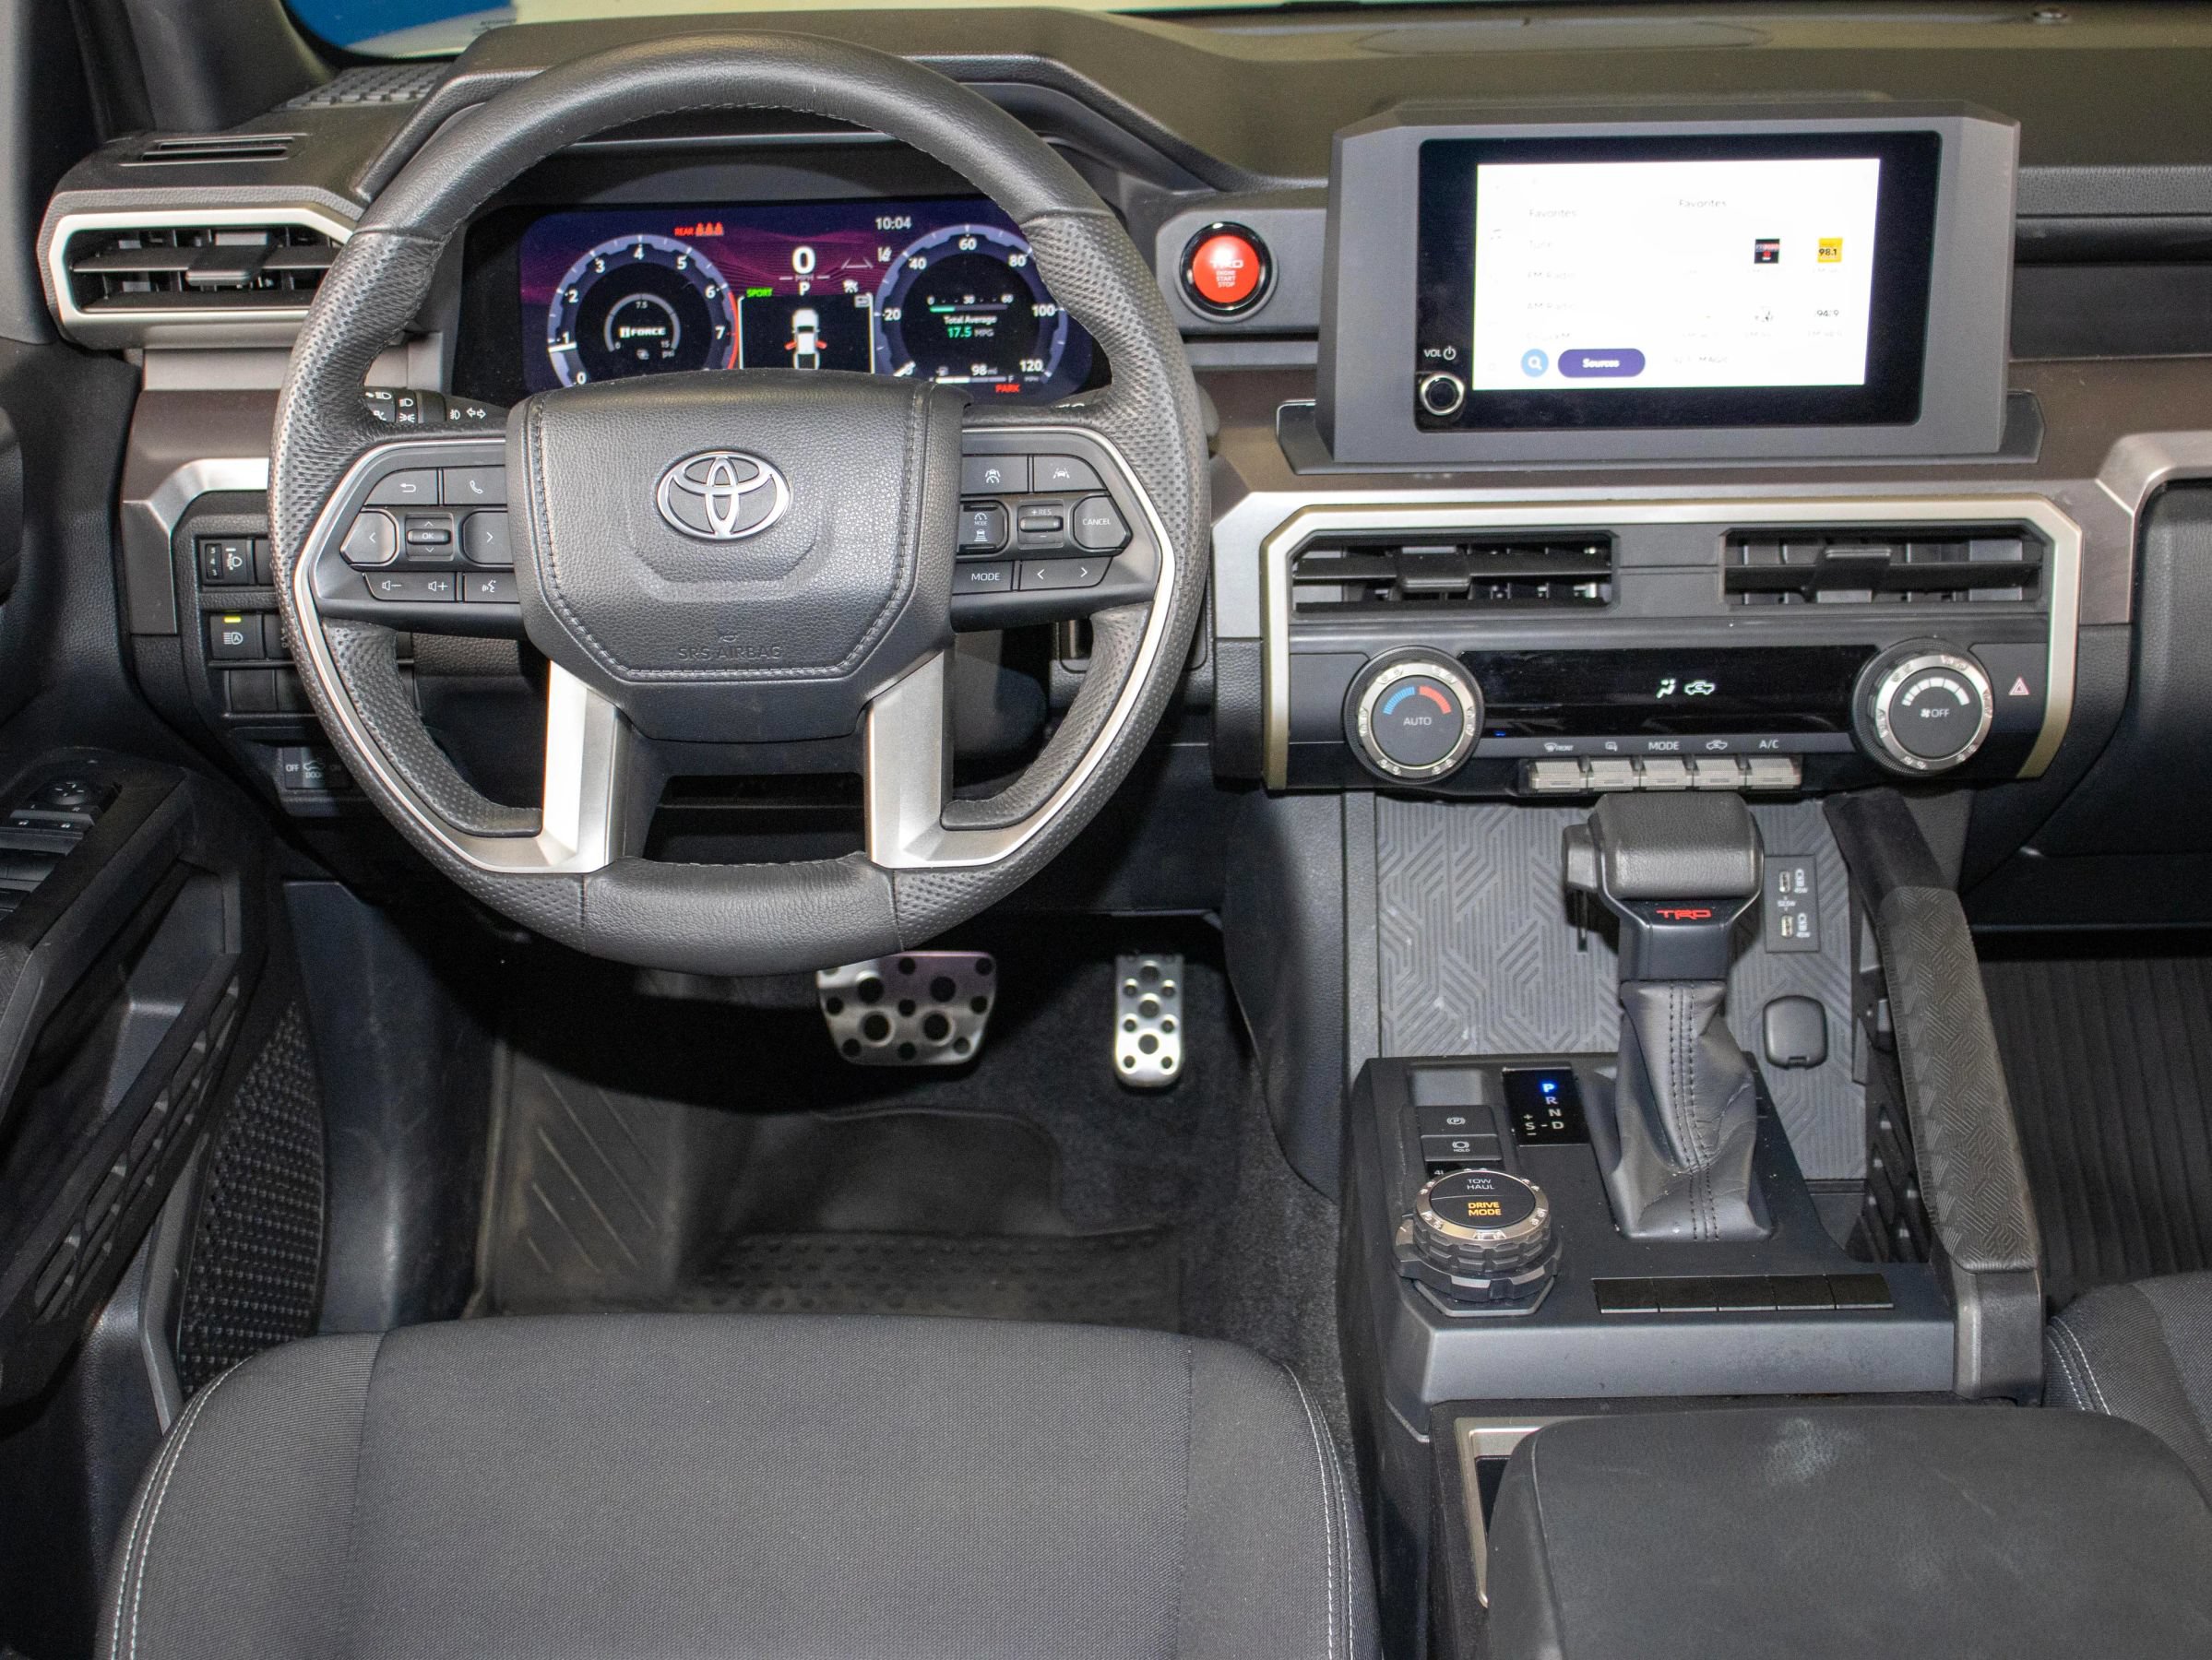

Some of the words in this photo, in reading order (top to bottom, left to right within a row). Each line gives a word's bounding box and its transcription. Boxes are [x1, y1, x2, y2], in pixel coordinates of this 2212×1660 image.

[876, 217, 912, 230] 10:04
[674, 227, 694, 236] REAR
[958, 238, 977, 250] 60
[633, 245, 644, 260] 4
[596, 259, 606, 273] 3
[676, 255, 687, 270] 5
[792, 245, 815, 275] 0
[910, 256, 927, 269] 40
[1008, 255, 1026, 267] 80
[705, 284, 716, 299] 6
[746, 288, 773, 298] SPORT
[799, 281, 810, 296] P
[568, 289, 579, 303] 2
[884, 308, 902, 321] 20
[1031, 304, 1055, 316] 100
[944, 314, 964, 325] Total
[964, 314, 997, 326] Average
[562, 331, 570, 344] 1
[714, 326, 725, 339] 7
[946, 326, 972, 338] 17.5
[1424, 349, 1441, 358] VOL
[971, 363, 988, 375] 98
[1019, 359, 1043, 372] 120
[1582, 358, 1620, 369] Sources
[577, 372, 587, 385] 0
[994, 383, 1020, 393] PARK
[971, 573, 1001, 581] MODE
[1931, 709, 1950, 717] OFF
[1403, 717, 1432, 726] AUTO
[1648, 741, 1679, 751] MODE
[1759, 740, 1779, 749] A/C
[1656, 908, 1713, 920] TRD
[1542, 1083, 1555, 1093] P
[1546, 1097, 1558, 1105] R
[1549, 1109, 1562, 1117] N
[1525, 1121, 1536, 1130] S
[1552, 1121, 1564, 1130] D
[1468, 1208, 1502, 1216] MODE
